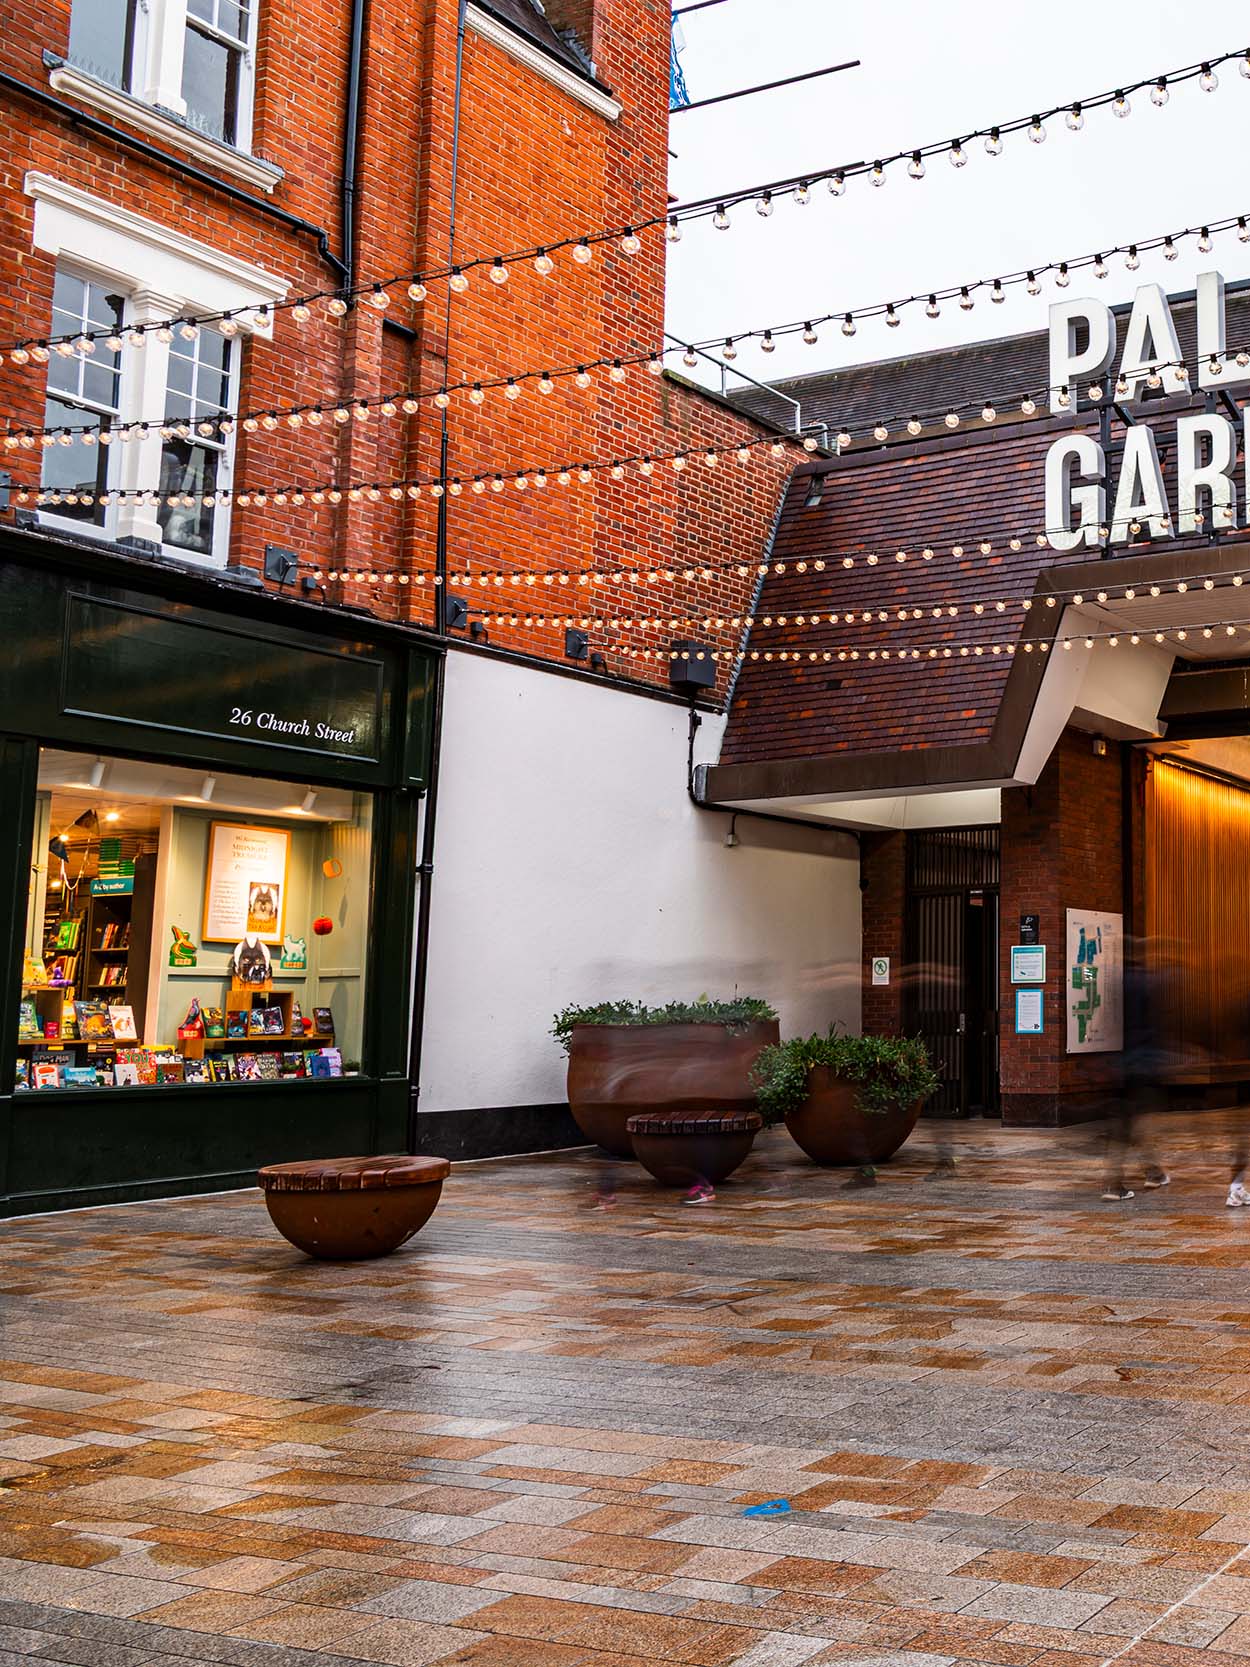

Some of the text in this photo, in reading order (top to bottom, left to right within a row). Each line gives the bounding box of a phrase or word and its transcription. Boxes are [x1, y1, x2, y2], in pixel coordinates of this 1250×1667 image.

[229, 707, 356, 744] 26 Church Street
